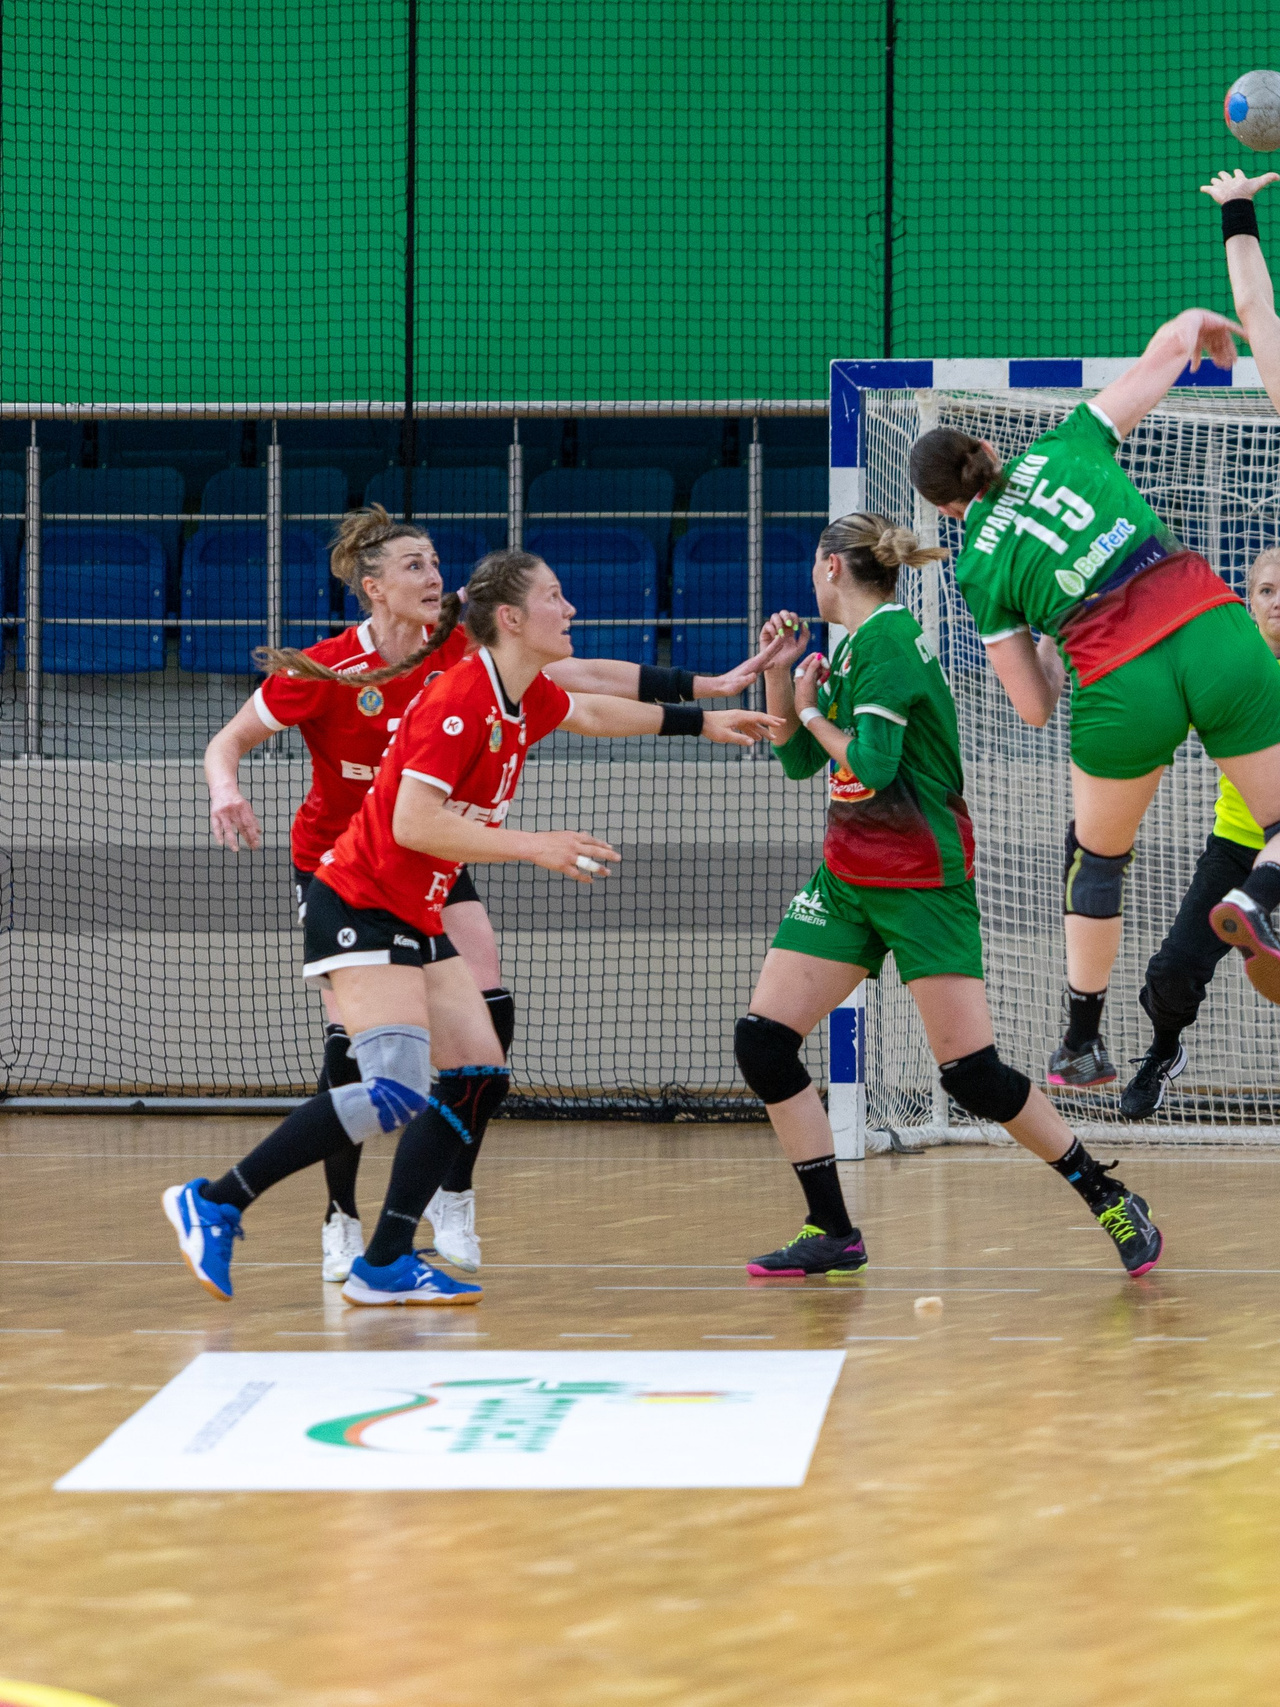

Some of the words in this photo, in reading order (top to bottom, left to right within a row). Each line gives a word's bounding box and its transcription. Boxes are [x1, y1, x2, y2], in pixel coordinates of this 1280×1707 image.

[974, 453, 1050, 555] КРАВЧЕНКО
[1013, 478, 1096, 555] 15
[1073, 517, 1136, 580] BelFert
